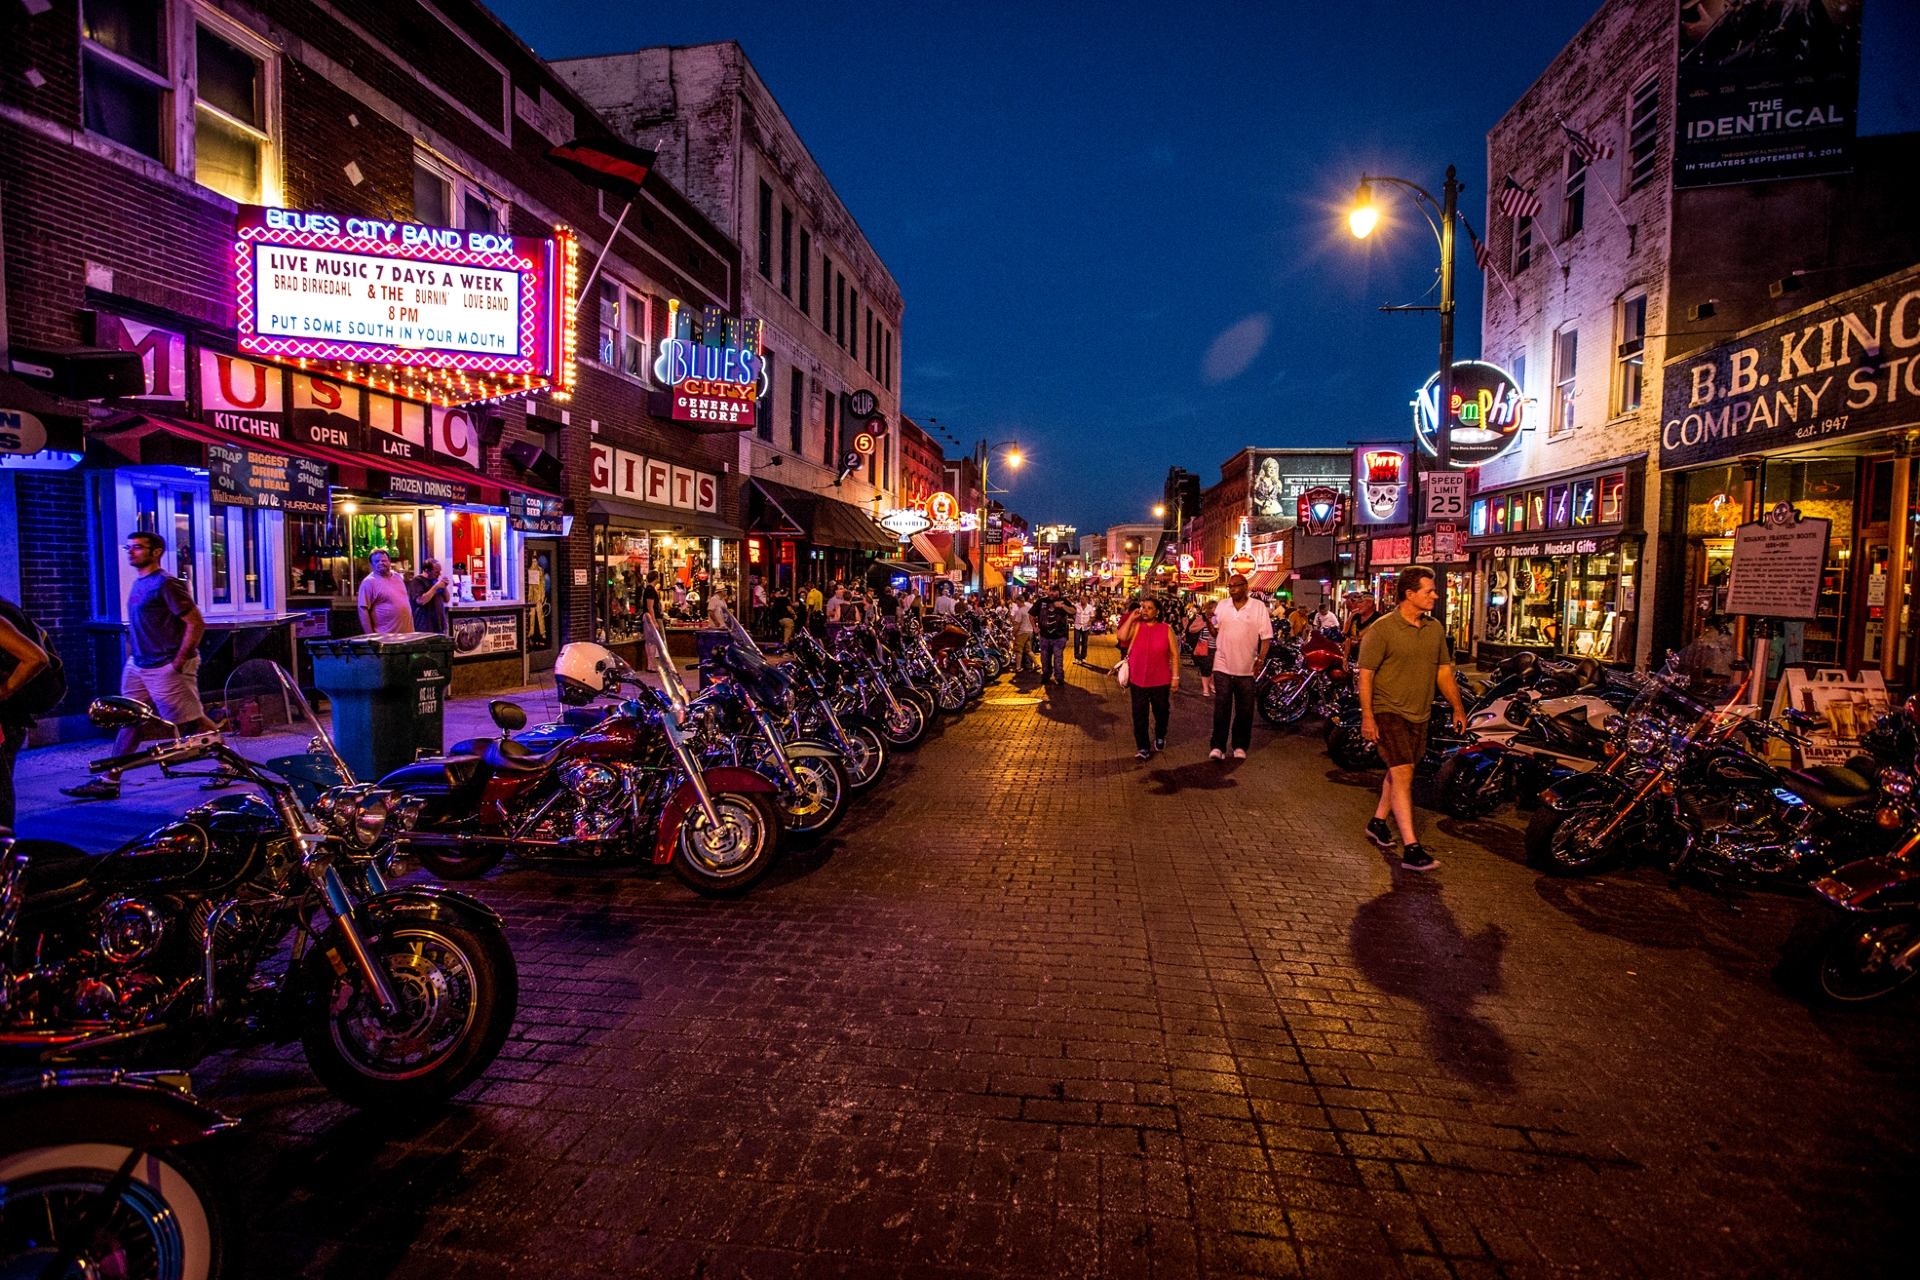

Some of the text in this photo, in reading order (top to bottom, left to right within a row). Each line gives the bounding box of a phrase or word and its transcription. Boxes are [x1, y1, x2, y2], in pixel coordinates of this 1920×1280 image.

[1748, 98, 1783, 112] THE
[1687, 104, 1844, 140] IDENTICAL
[1698, 158, 1746, 169] THEATERS
[1748, 152, 1805, 164] SEPTEMBER
[1820, 148, 1843, 156] 2014
[266, 208, 514, 254] BLUES CITY BAND BOX
[271, 254, 504, 292] LIVE MUSIC 7 DAYS A WEEK
[274, 275, 299, 292] BRAD
[302, 278, 352, 297] BIRKEDAHL
[367, 284, 376, 300] &
[381, 286, 404, 302] THE
[463, 294, 484, 310] LOVE
[486, 296, 509, 312] BAND
[388, 306, 418, 322] 8 PM
[272, 314, 505, 348] PUT SOME SOUTH IN YOUR MOUTH
[671, 340, 753, 386] BLUES
[1688, 348, 1770, 408] B.B.
[684, 380, 754, 400] CITY
[678, 398, 749, 413] GENERAL
[852, 393, 874, 414] CLUB
[690, 408, 738, 422] STORE
[1663, 376, 1833, 450] COMPANY
[214, 412, 280, 440] KITCHEN
[1795, 416, 1848, 438] est. 1947
[310, 426, 348, 446] OPEN
[210, 446, 242, 464] STRAP
[382, 439, 412, 457] LATE
[222, 462, 231, 474] IT
[248, 452, 290, 468] BIGGEST
[252, 466, 286, 480] DRINK
[298, 473, 324, 488] SHARE
[590, 447, 714, 508] GIFTS
[218, 476, 234, 490] ON
[249, 478, 290, 492] ON BEALE
[308, 486, 315, 496] IT
[390, 476, 452, 498] FROZEN DRINKS
[258, 492, 269, 506] 100
[283, 500, 328, 512] HURRICANE
[526, 498, 540, 507] COLD
[1431, 496, 1462, 513] 25
[526, 508, 540, 516] BEER
[1494, 546, 1506, 557] CDs
[1511, 544, 1539, 556] Records
[1544, 541, 1574, 554] Musical
[1576, 539, 1597, 553] Gifts
[473, 558, 483, 568] We
[420, 687, 436, 700] BEALE
[418, 700, 437, 714] STREET
[1804, 748, 1852, 757] HAPPY
